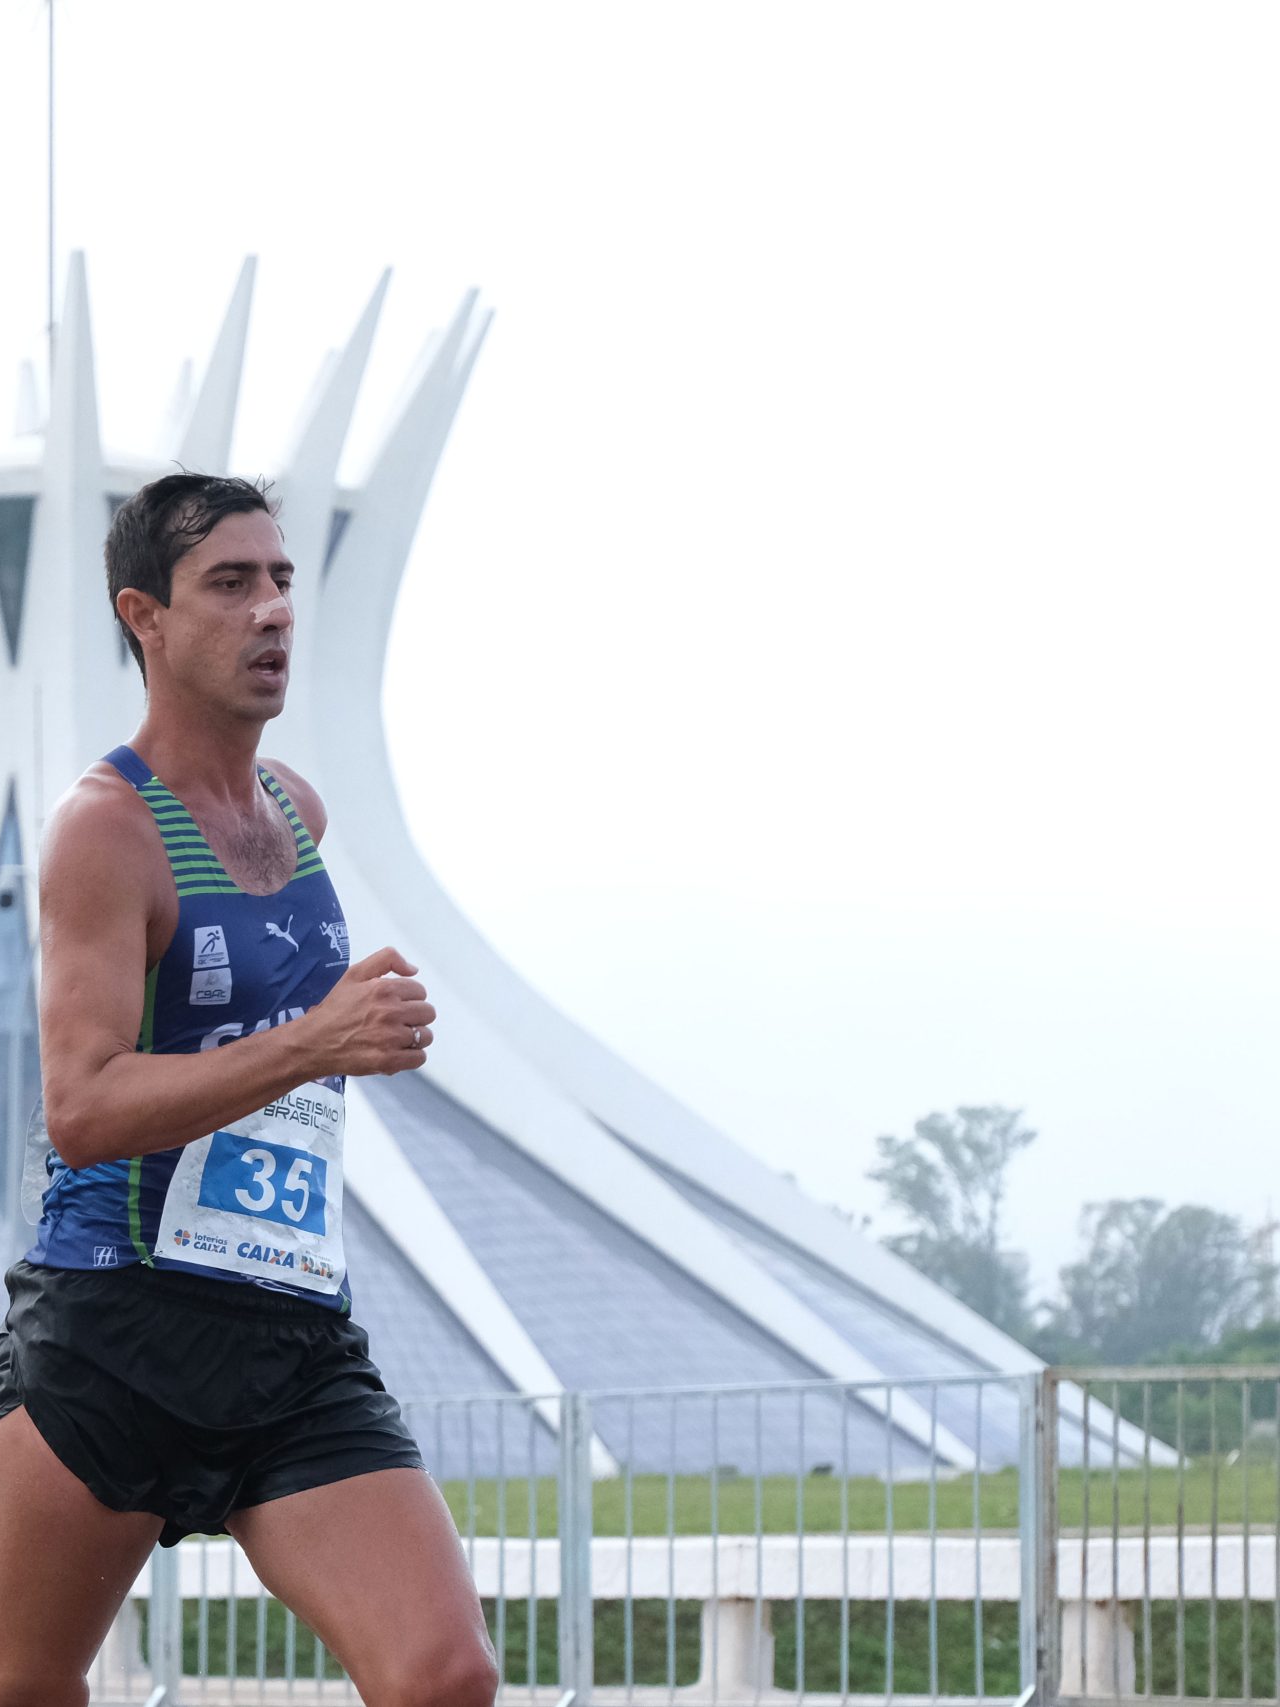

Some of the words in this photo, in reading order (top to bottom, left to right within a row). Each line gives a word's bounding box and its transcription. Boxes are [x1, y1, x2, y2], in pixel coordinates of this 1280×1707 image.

[263, 1104, 320, 1128] BRASIL
[275, 1094, 339, 1122] TLETISMO
[234, 1149, 312, 1221] 35
[193, 1241, 227, 1254] CAIXA
[194, 1232, 228, 1246] loterias
[237, 1242, 294, 1268] CAIXA
